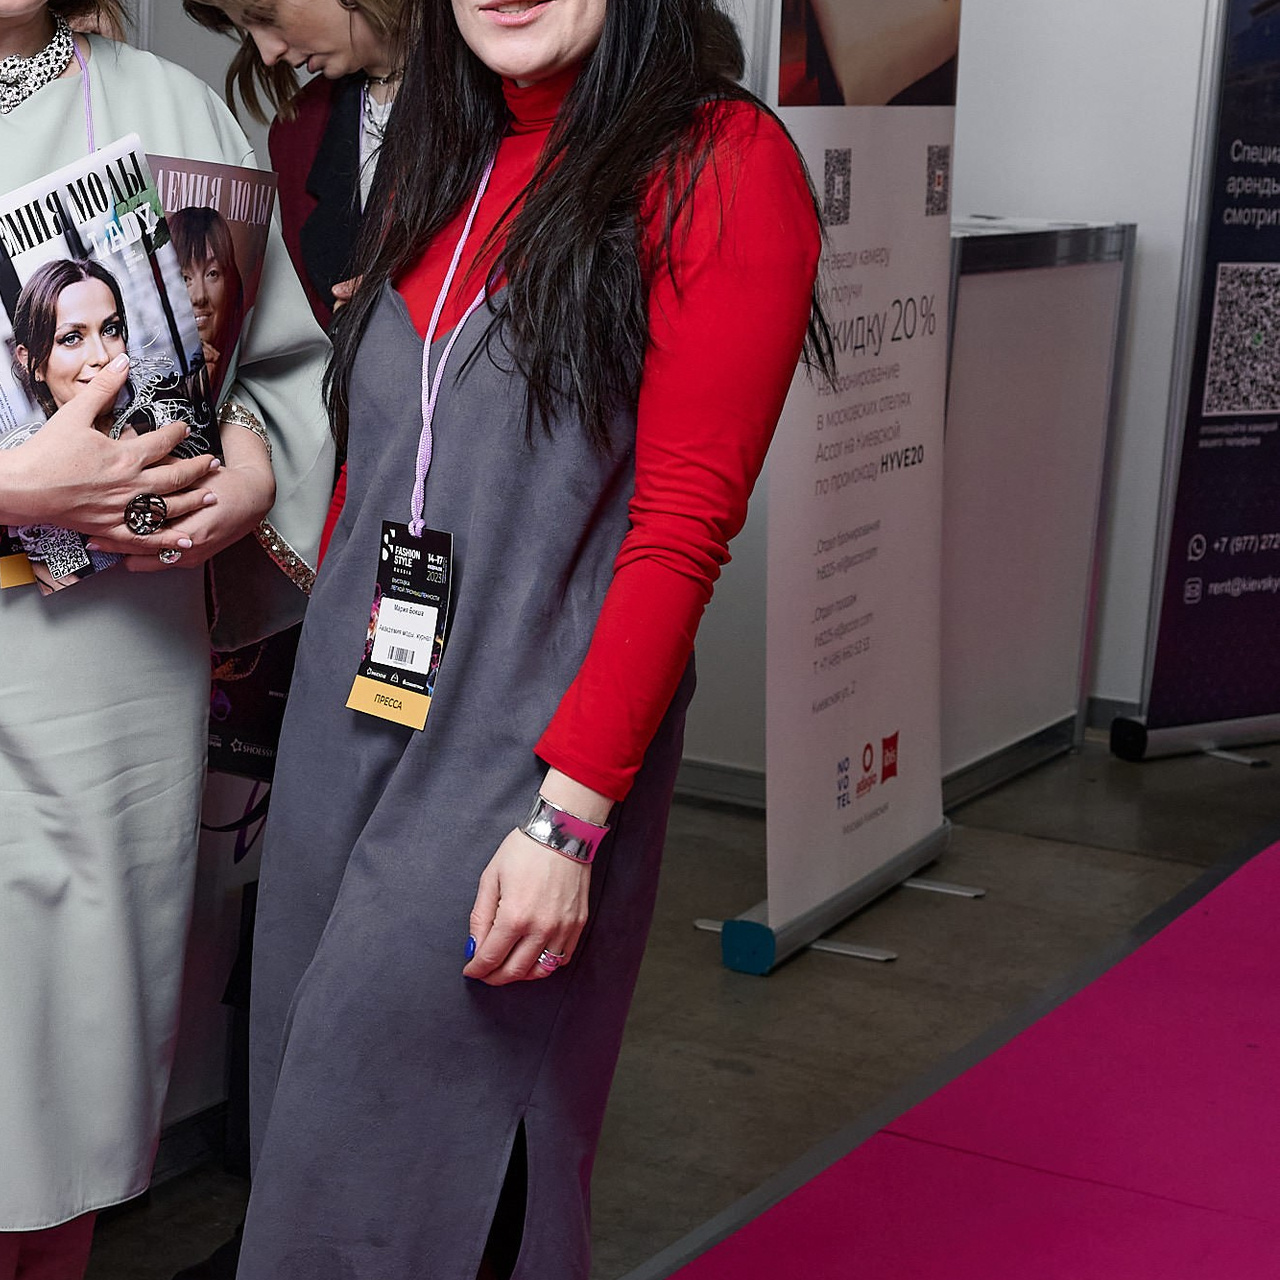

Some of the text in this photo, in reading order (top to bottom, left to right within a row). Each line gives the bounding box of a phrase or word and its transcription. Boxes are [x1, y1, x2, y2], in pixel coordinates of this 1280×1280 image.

[66, 150, 149, 225] МОДЫ
[227, 179, 272, 229] МОДЫ
[87, 202, 158, 261] LADY
[880, 443, 925, 474] HYVE20
[393, 555, 413, 568] STYLE
[395, 545, 421, 560] FASHION
[426, 570, 442, 584] 2023
[373, 692, 403, 711] ПРЕССА
